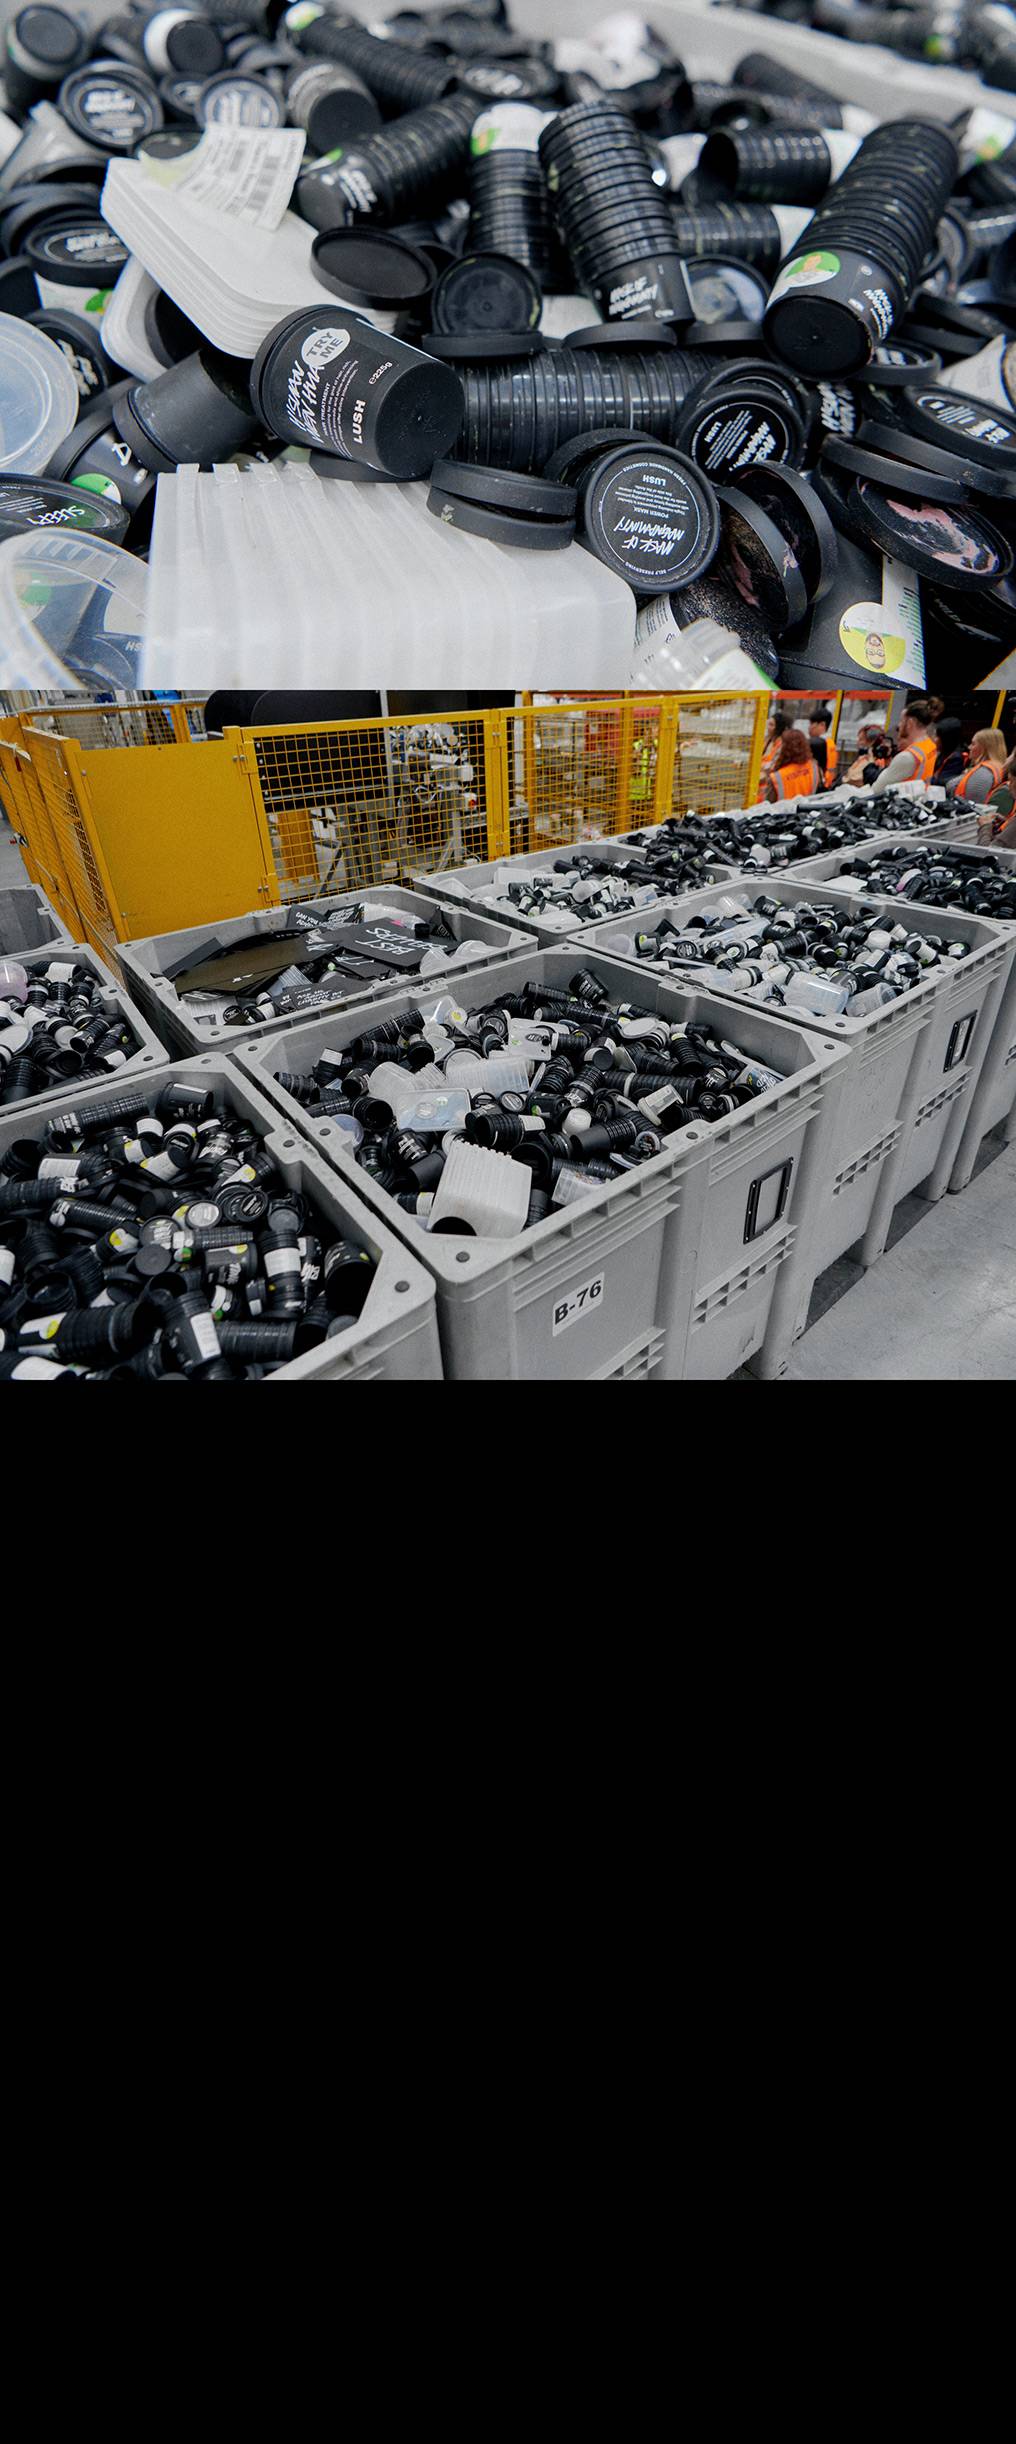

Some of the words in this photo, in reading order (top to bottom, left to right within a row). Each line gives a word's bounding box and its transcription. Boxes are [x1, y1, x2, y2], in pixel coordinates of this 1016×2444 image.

[306, 332, 332, 357] TRY
[320, 338, 343, 358] ME
[321, 382, 331, 420] TREATMENT
[352, 400, 367, 444] LUSH
[704, 421, 722, 443] LUSH
[642, 474, 667, 486] LUSH
[26, 505, 85, 525] SLEEPY
[633, 506, 649, 514] MASK
[649, 510, 669, 519] POWER
[613, 516, 685, 541] MAGNAMINTY
[622, 535, 639, 549] OF
[639, 539, 675, 556] MASK
[355, 939, 416, 956] BEST
[555, 1280, 601, 1325] B-76
